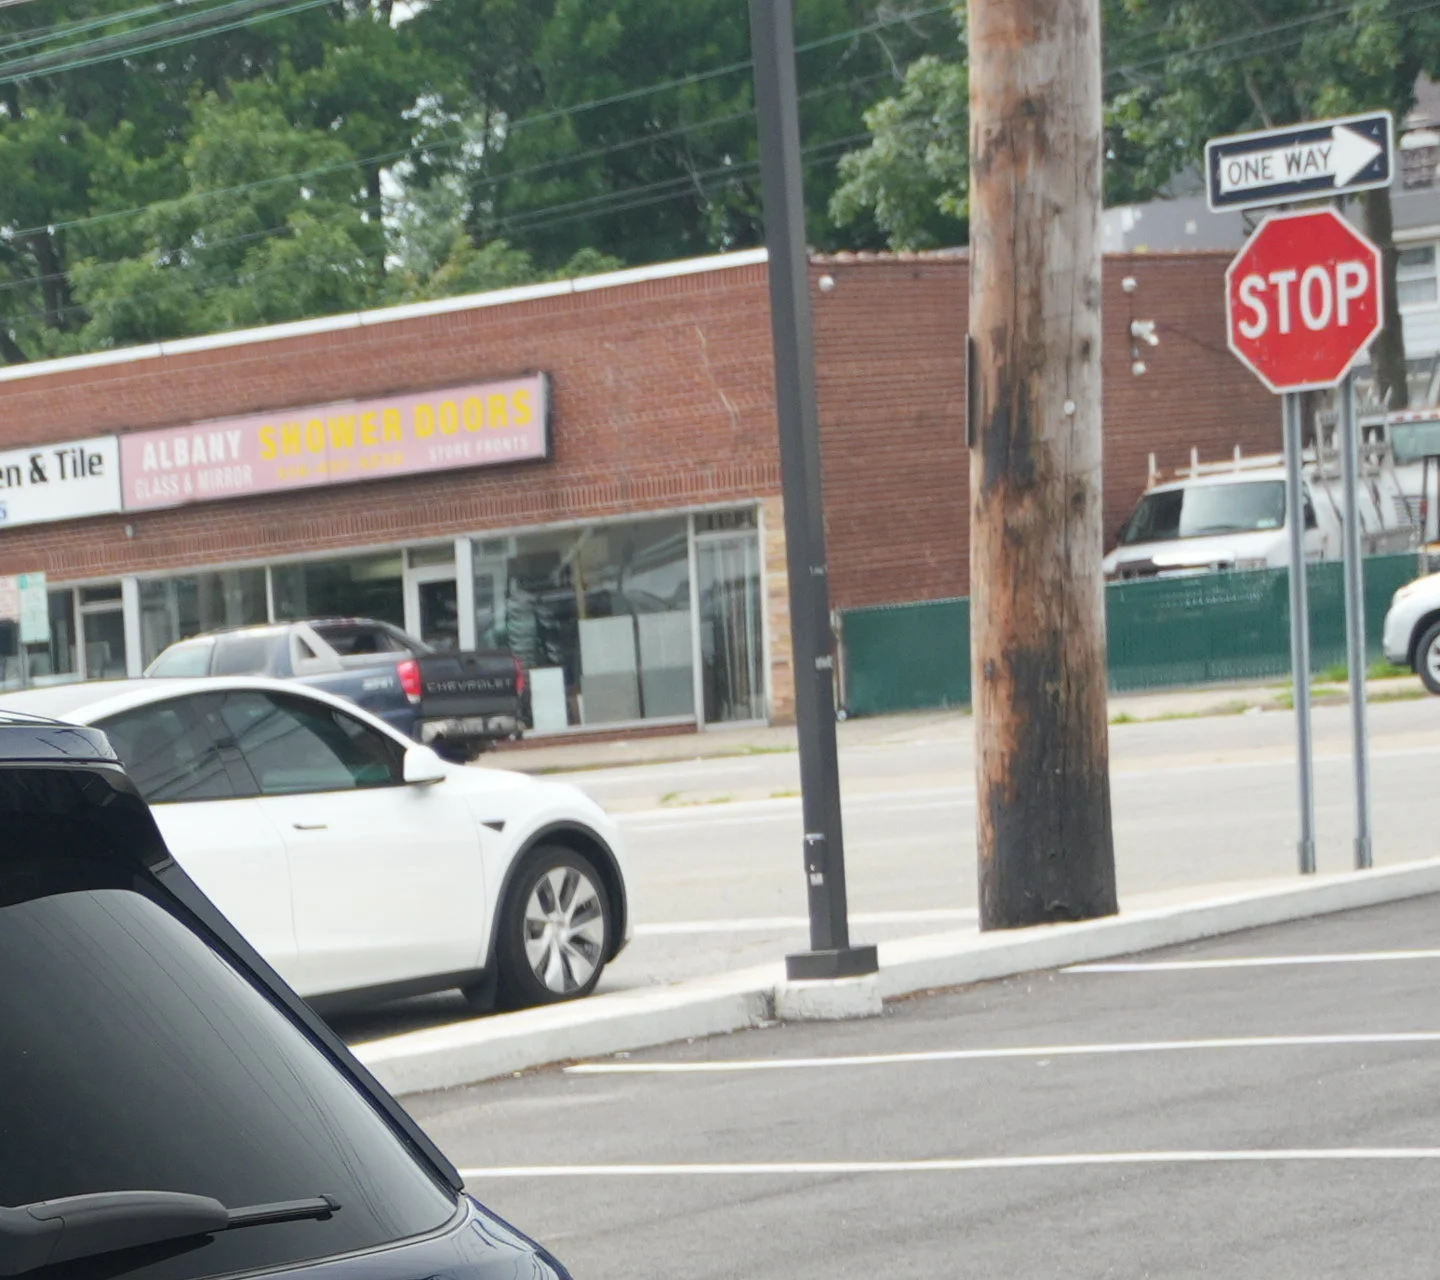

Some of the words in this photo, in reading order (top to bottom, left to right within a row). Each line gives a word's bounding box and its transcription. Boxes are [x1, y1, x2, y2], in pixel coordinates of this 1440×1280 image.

[1227, 156, 1276, 185] ONE
[1284, 147, 1332, 177] WAY
[1238, 261, 1369, 339] STOP
[259, 407, 403, 461] SHOWER
[415, 389, 532, 439] DOORS
[29, 455, 48, 484] &
[54, 447, 104, 480] Tile
[143, 430, 242, 472] ALBANY
[135, 473, 179, 500] GLASS
[197, 464, 252, 493] MIRROR
[427, 678, 513, 693] CHEVROLET
